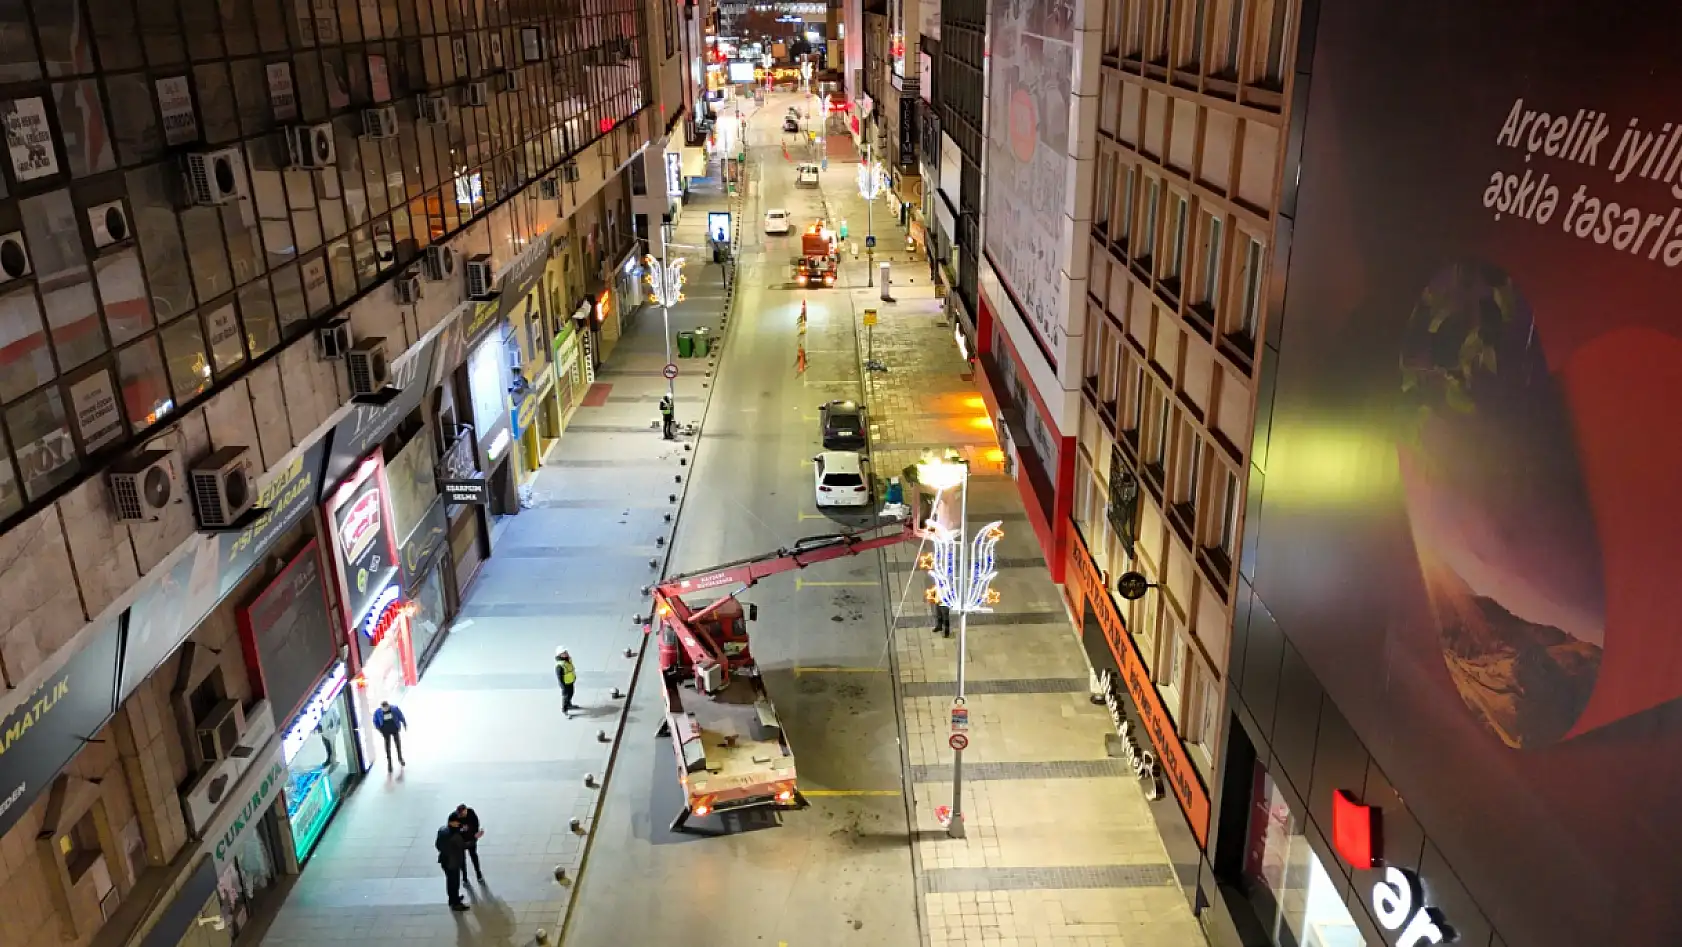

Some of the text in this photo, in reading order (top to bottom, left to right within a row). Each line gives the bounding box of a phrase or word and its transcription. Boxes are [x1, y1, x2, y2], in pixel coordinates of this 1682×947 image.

[1496, 98, 1682, 200] Arçelik iyili
[1482, 169, 1559, 225] aşkla
[452, 493, 478, 501] SELMA
[216, 763, 282, 861] ÇUKUROVA
